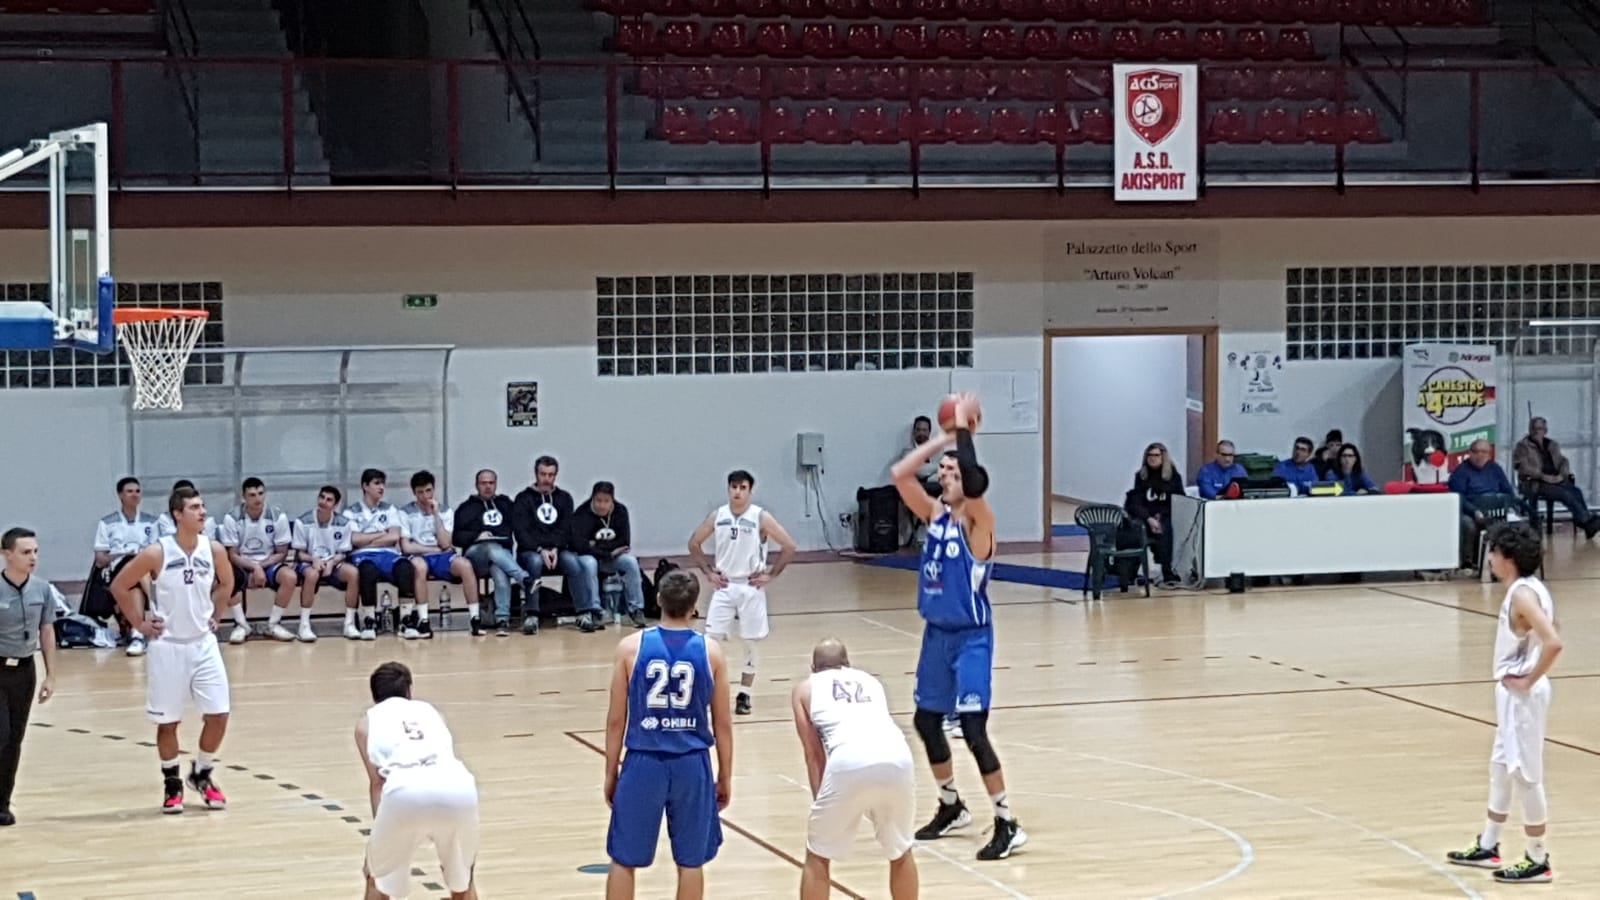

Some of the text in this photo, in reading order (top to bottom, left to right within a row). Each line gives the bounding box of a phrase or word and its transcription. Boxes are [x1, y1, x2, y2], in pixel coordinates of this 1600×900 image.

[1134, 152, 1172, 169] A.S.D.
[1121, 173, 1186, 190] AKISPORT
[1066, 241, 1197, 257] Palazzetto dello Sport
[1428, 380, 1486, 392] CANESTRO
[1426, 393, 1444, 418] 4
[1443, 392, 1486, 407] ZAMPE
[646, 659, 695, 709] 23
[832, 679, 872, 703] 42
[402, 720, 424, 740] 5
